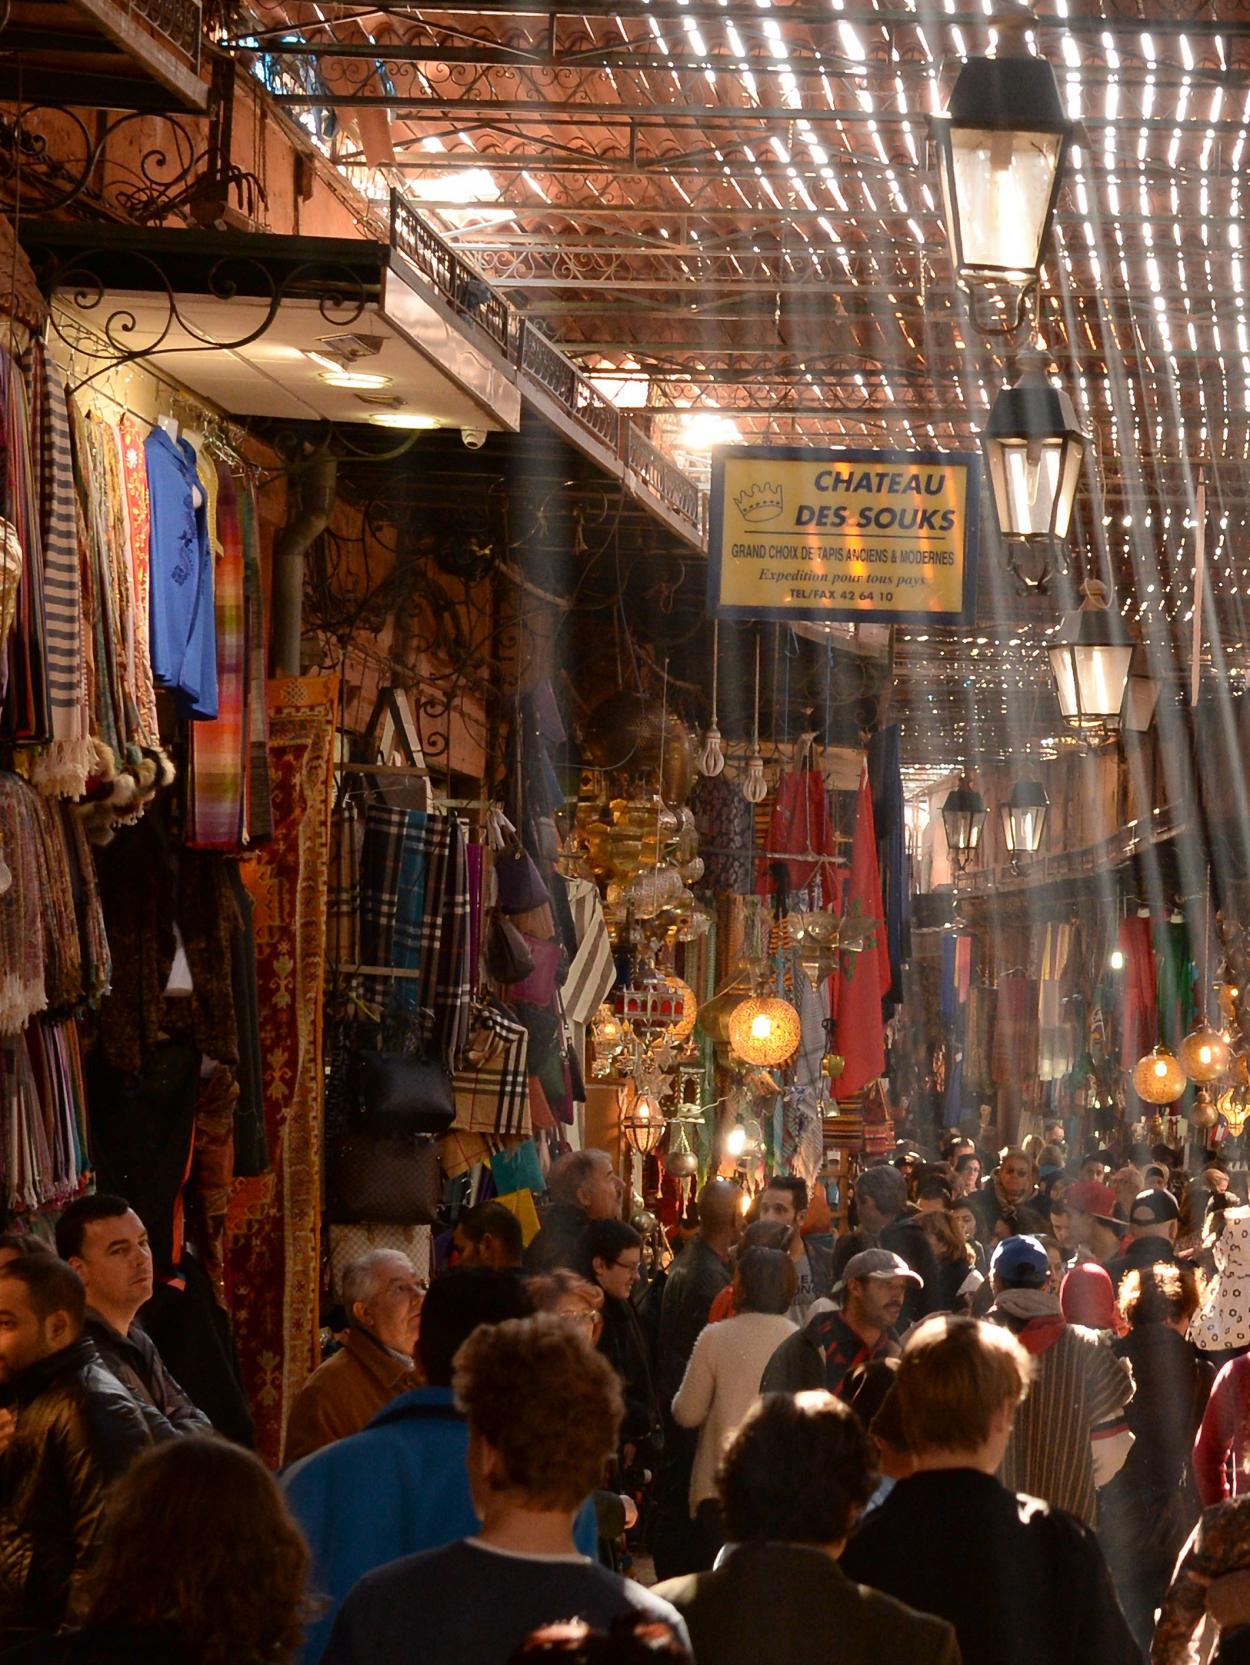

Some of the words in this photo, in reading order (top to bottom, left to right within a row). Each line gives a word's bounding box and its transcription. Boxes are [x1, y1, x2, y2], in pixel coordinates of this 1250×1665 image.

[814, 470, 945, 496] CHATEAU
[795, 504, 848, 528] DES
[855, 506, 956, 531] SOUKS
[731, 544, 766, 559] GRAND
[768, 546, 799, 560] CHOIX
[801, 546, 813, 561] DE
[816, 547, 844, 562] TAPIS
[846, 548, 889, 564] ANCIENS
[901, 550, 955, 566] MODERNES
[759, 568, 828, 583] Expedition
[831, 574, 863, 585] pour
[866, 573, 894, 584] tous
[896, 575, 926, 588] pays
[790, 588, 836, 600] TEL/FAX
[840, 589, 856, 601] 42
[859, 590, 874, 601] 64
[879, 591, 893, 602] 10
